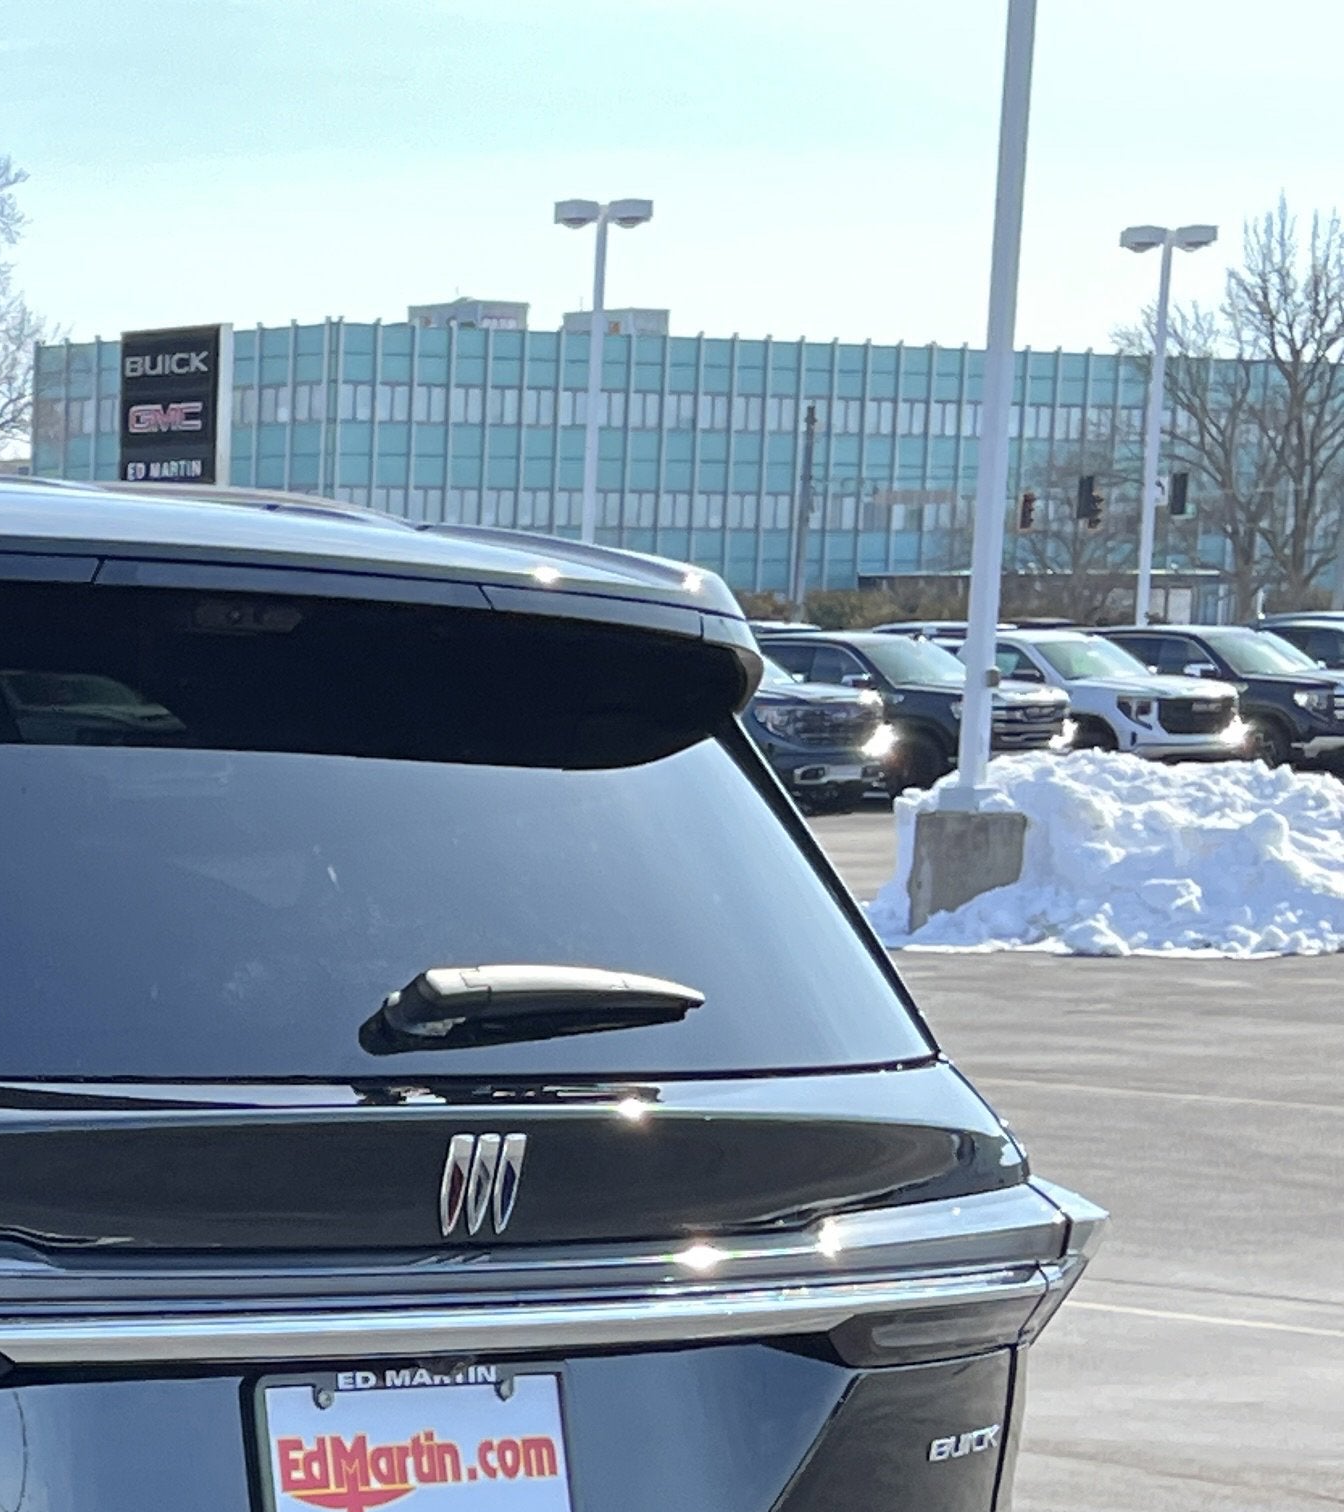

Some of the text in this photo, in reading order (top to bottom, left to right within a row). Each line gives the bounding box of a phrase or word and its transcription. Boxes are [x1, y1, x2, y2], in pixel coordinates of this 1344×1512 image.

[125, 351, 208, 378] BUICK
[128, 402, 203, 433] GMC
[127, 460, 202, 481] ED MARTIN
[337, 1371, 377, 1390] ED
[929, 1424, 1000, 1462] BUICK
[277, 1430, 558, 1494] EdMartin.com
